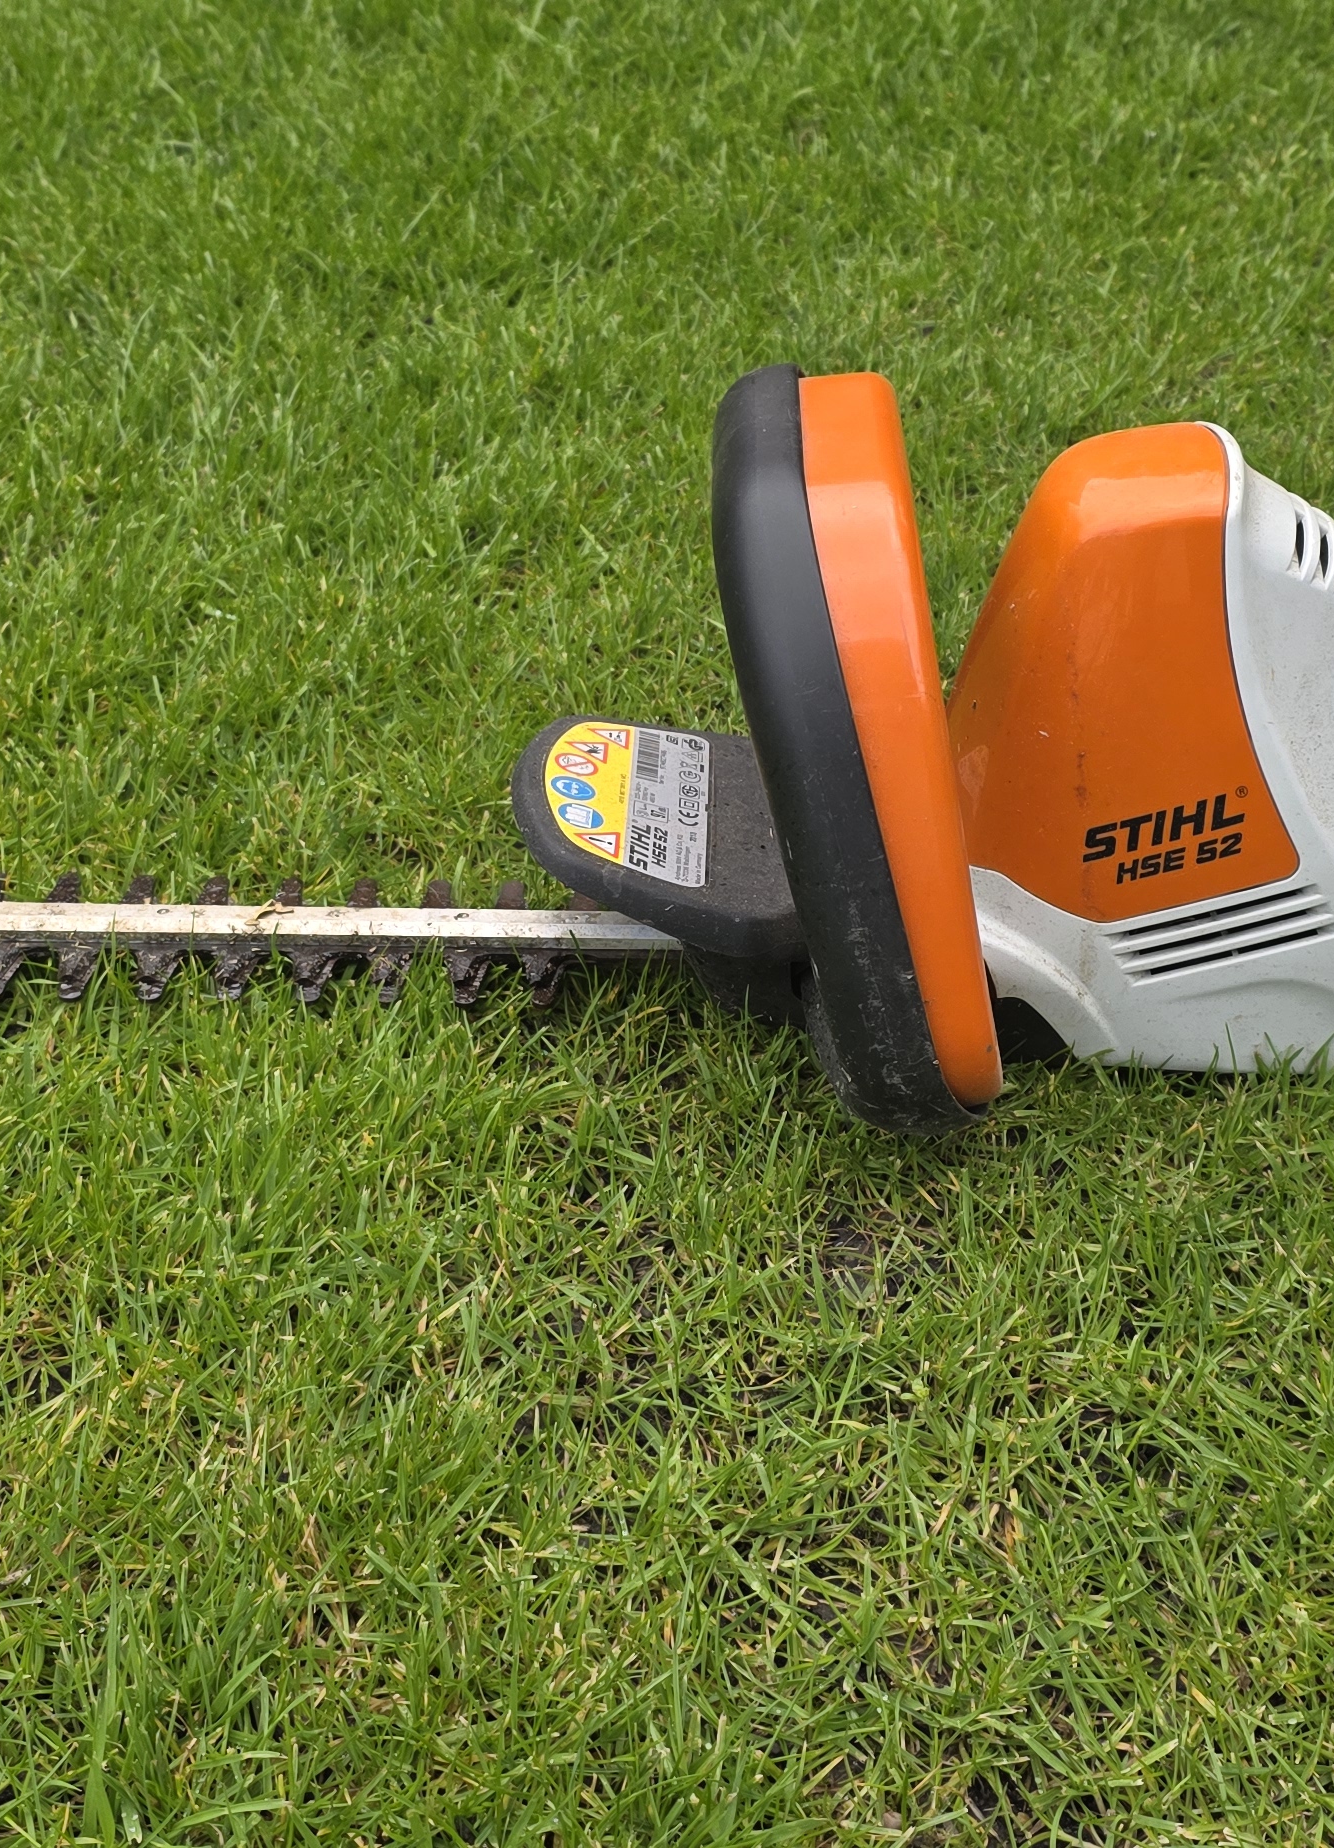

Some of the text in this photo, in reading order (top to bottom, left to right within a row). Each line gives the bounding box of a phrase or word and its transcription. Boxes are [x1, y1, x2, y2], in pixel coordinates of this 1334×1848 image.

[653, 827, 668, 843] 52
[651, 841, 667, 868] HSE
[1116, 833, 1243, 885] HSE 52
